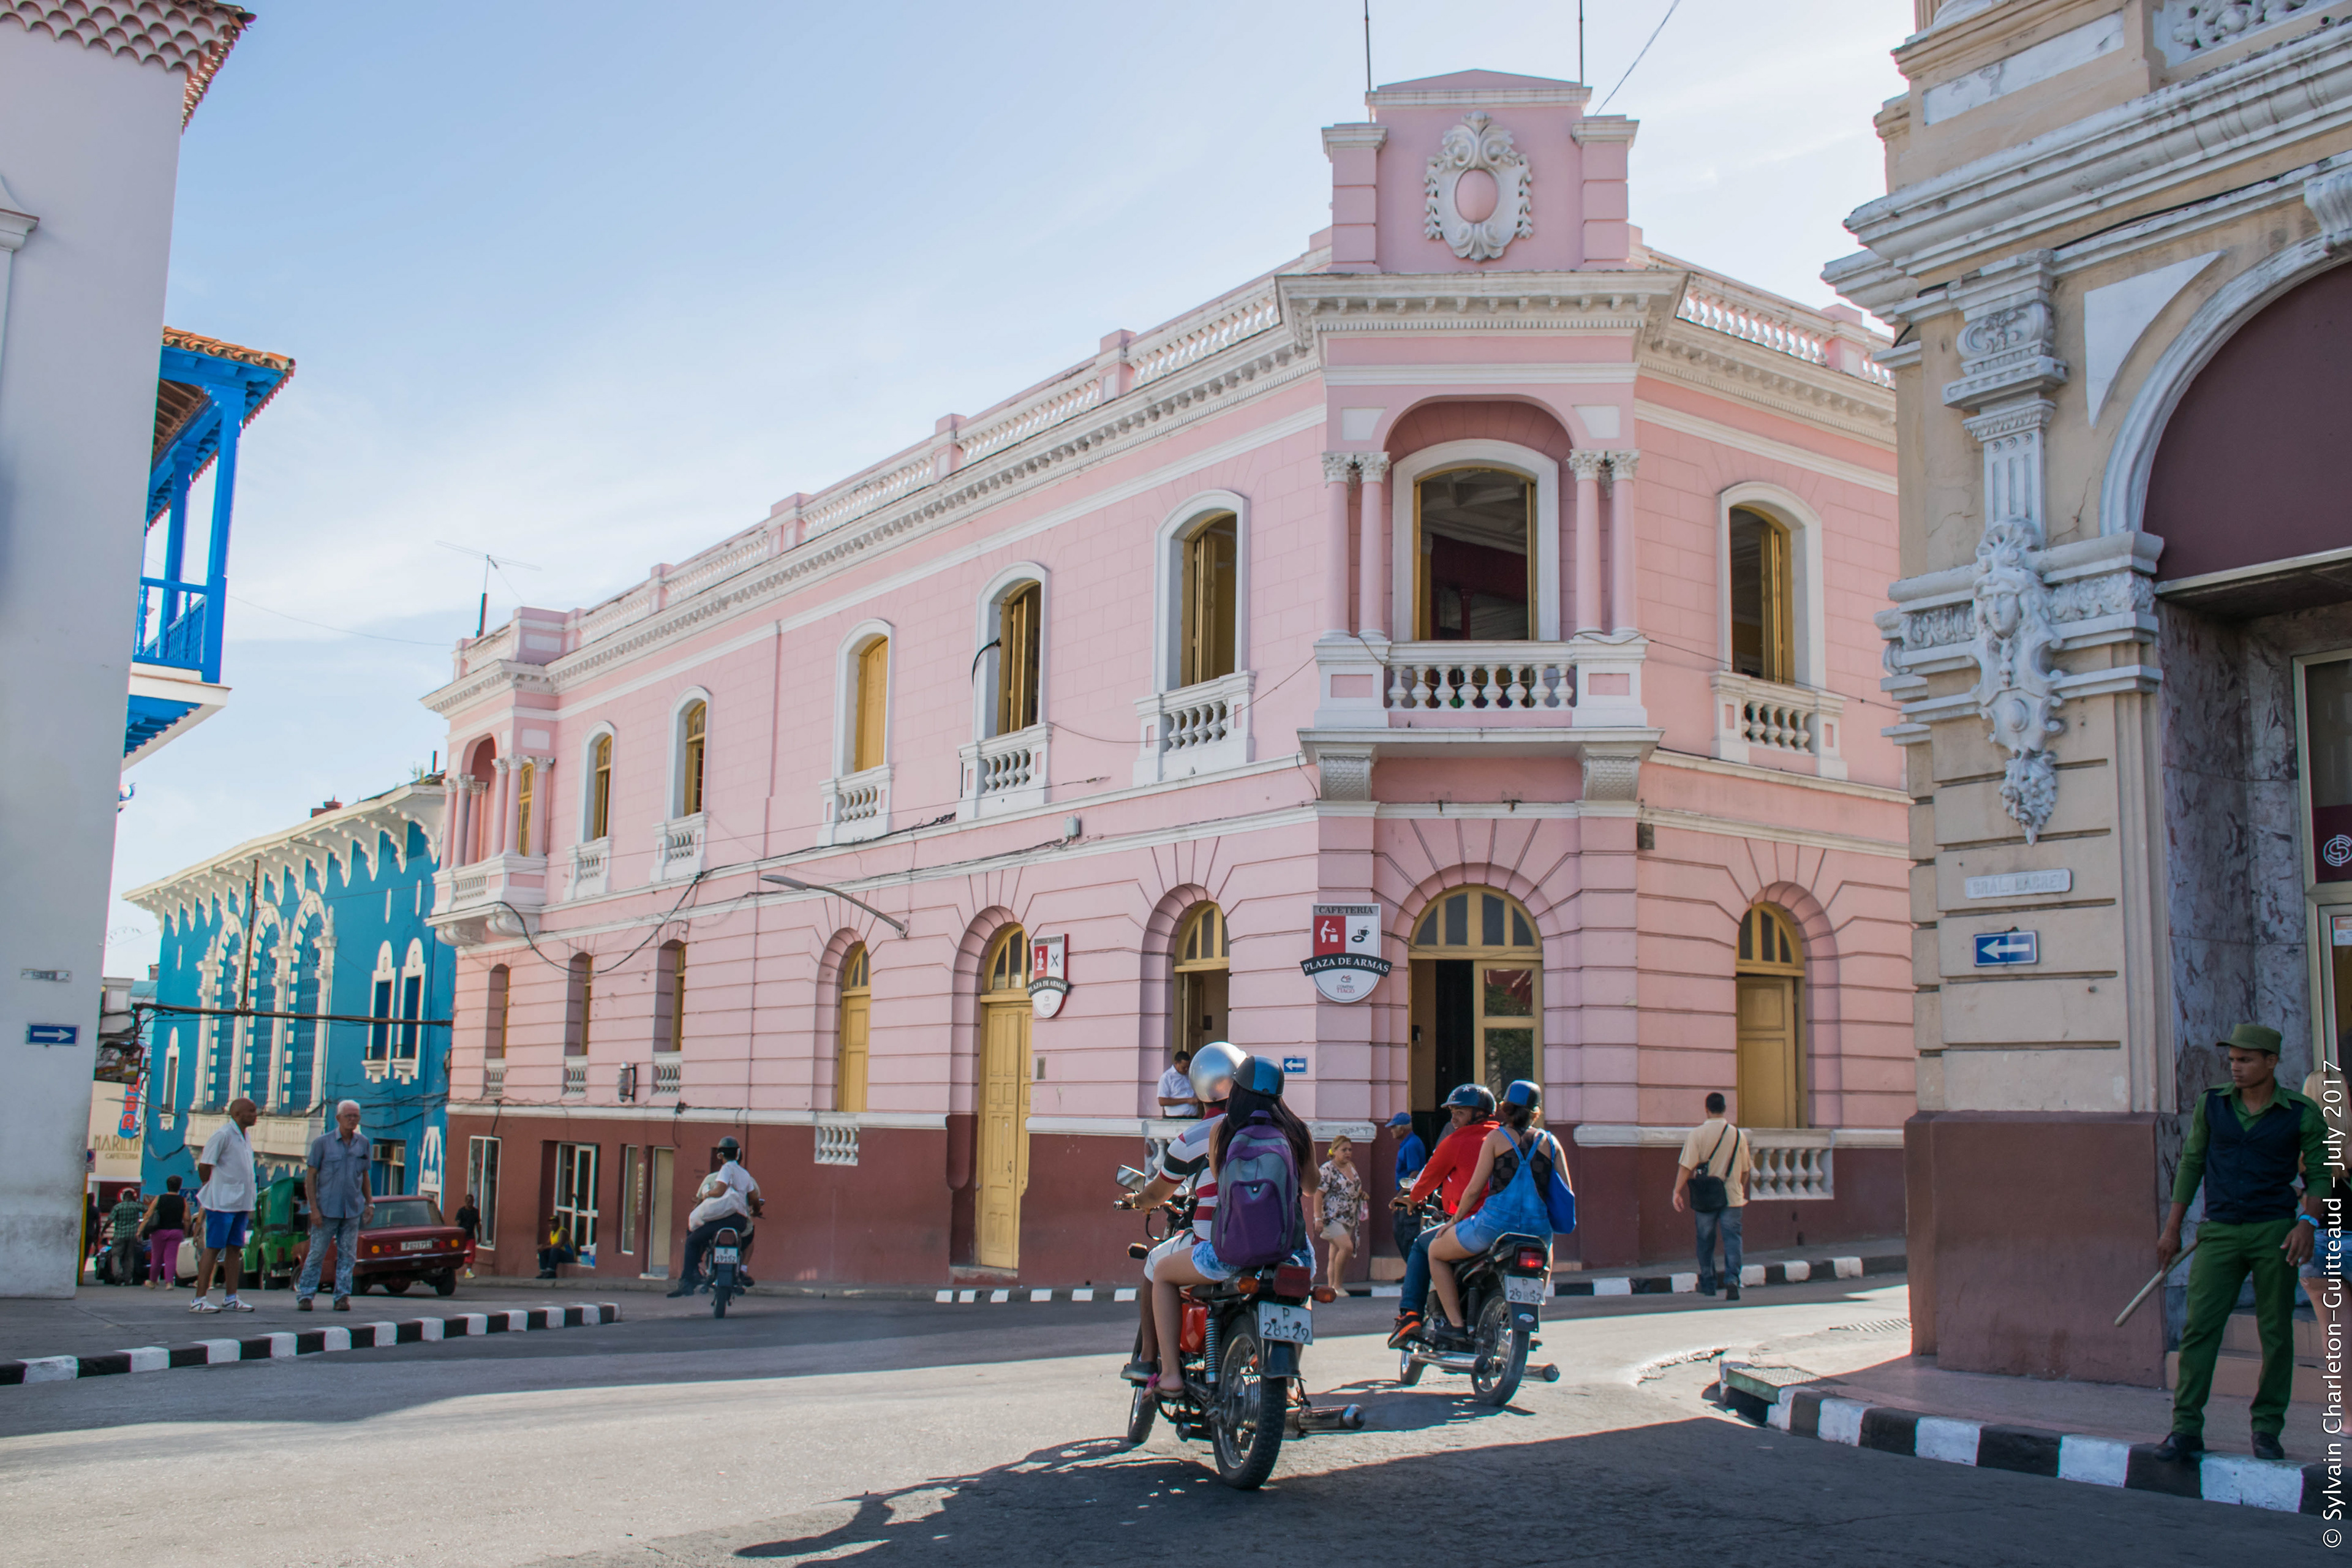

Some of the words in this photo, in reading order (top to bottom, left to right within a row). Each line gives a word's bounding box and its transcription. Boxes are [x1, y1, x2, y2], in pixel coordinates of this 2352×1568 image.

[1319, 905, 1373, 914] CAFETERÍA
[1303, 959, 1336, 973] PLAZA
[1338, 957, 1352, 965] DE
[1353, 958, 1390, 973] ARMAS
[1028, 981, 1042, 993] PLAZA
[1049, 980, 1066, 991] ARMAS
[94, 1134, 140, 1152] MARILYN
[1282, 1307, 1290, 1321] P
[1264, 1322, 1310, 1341] 28129
